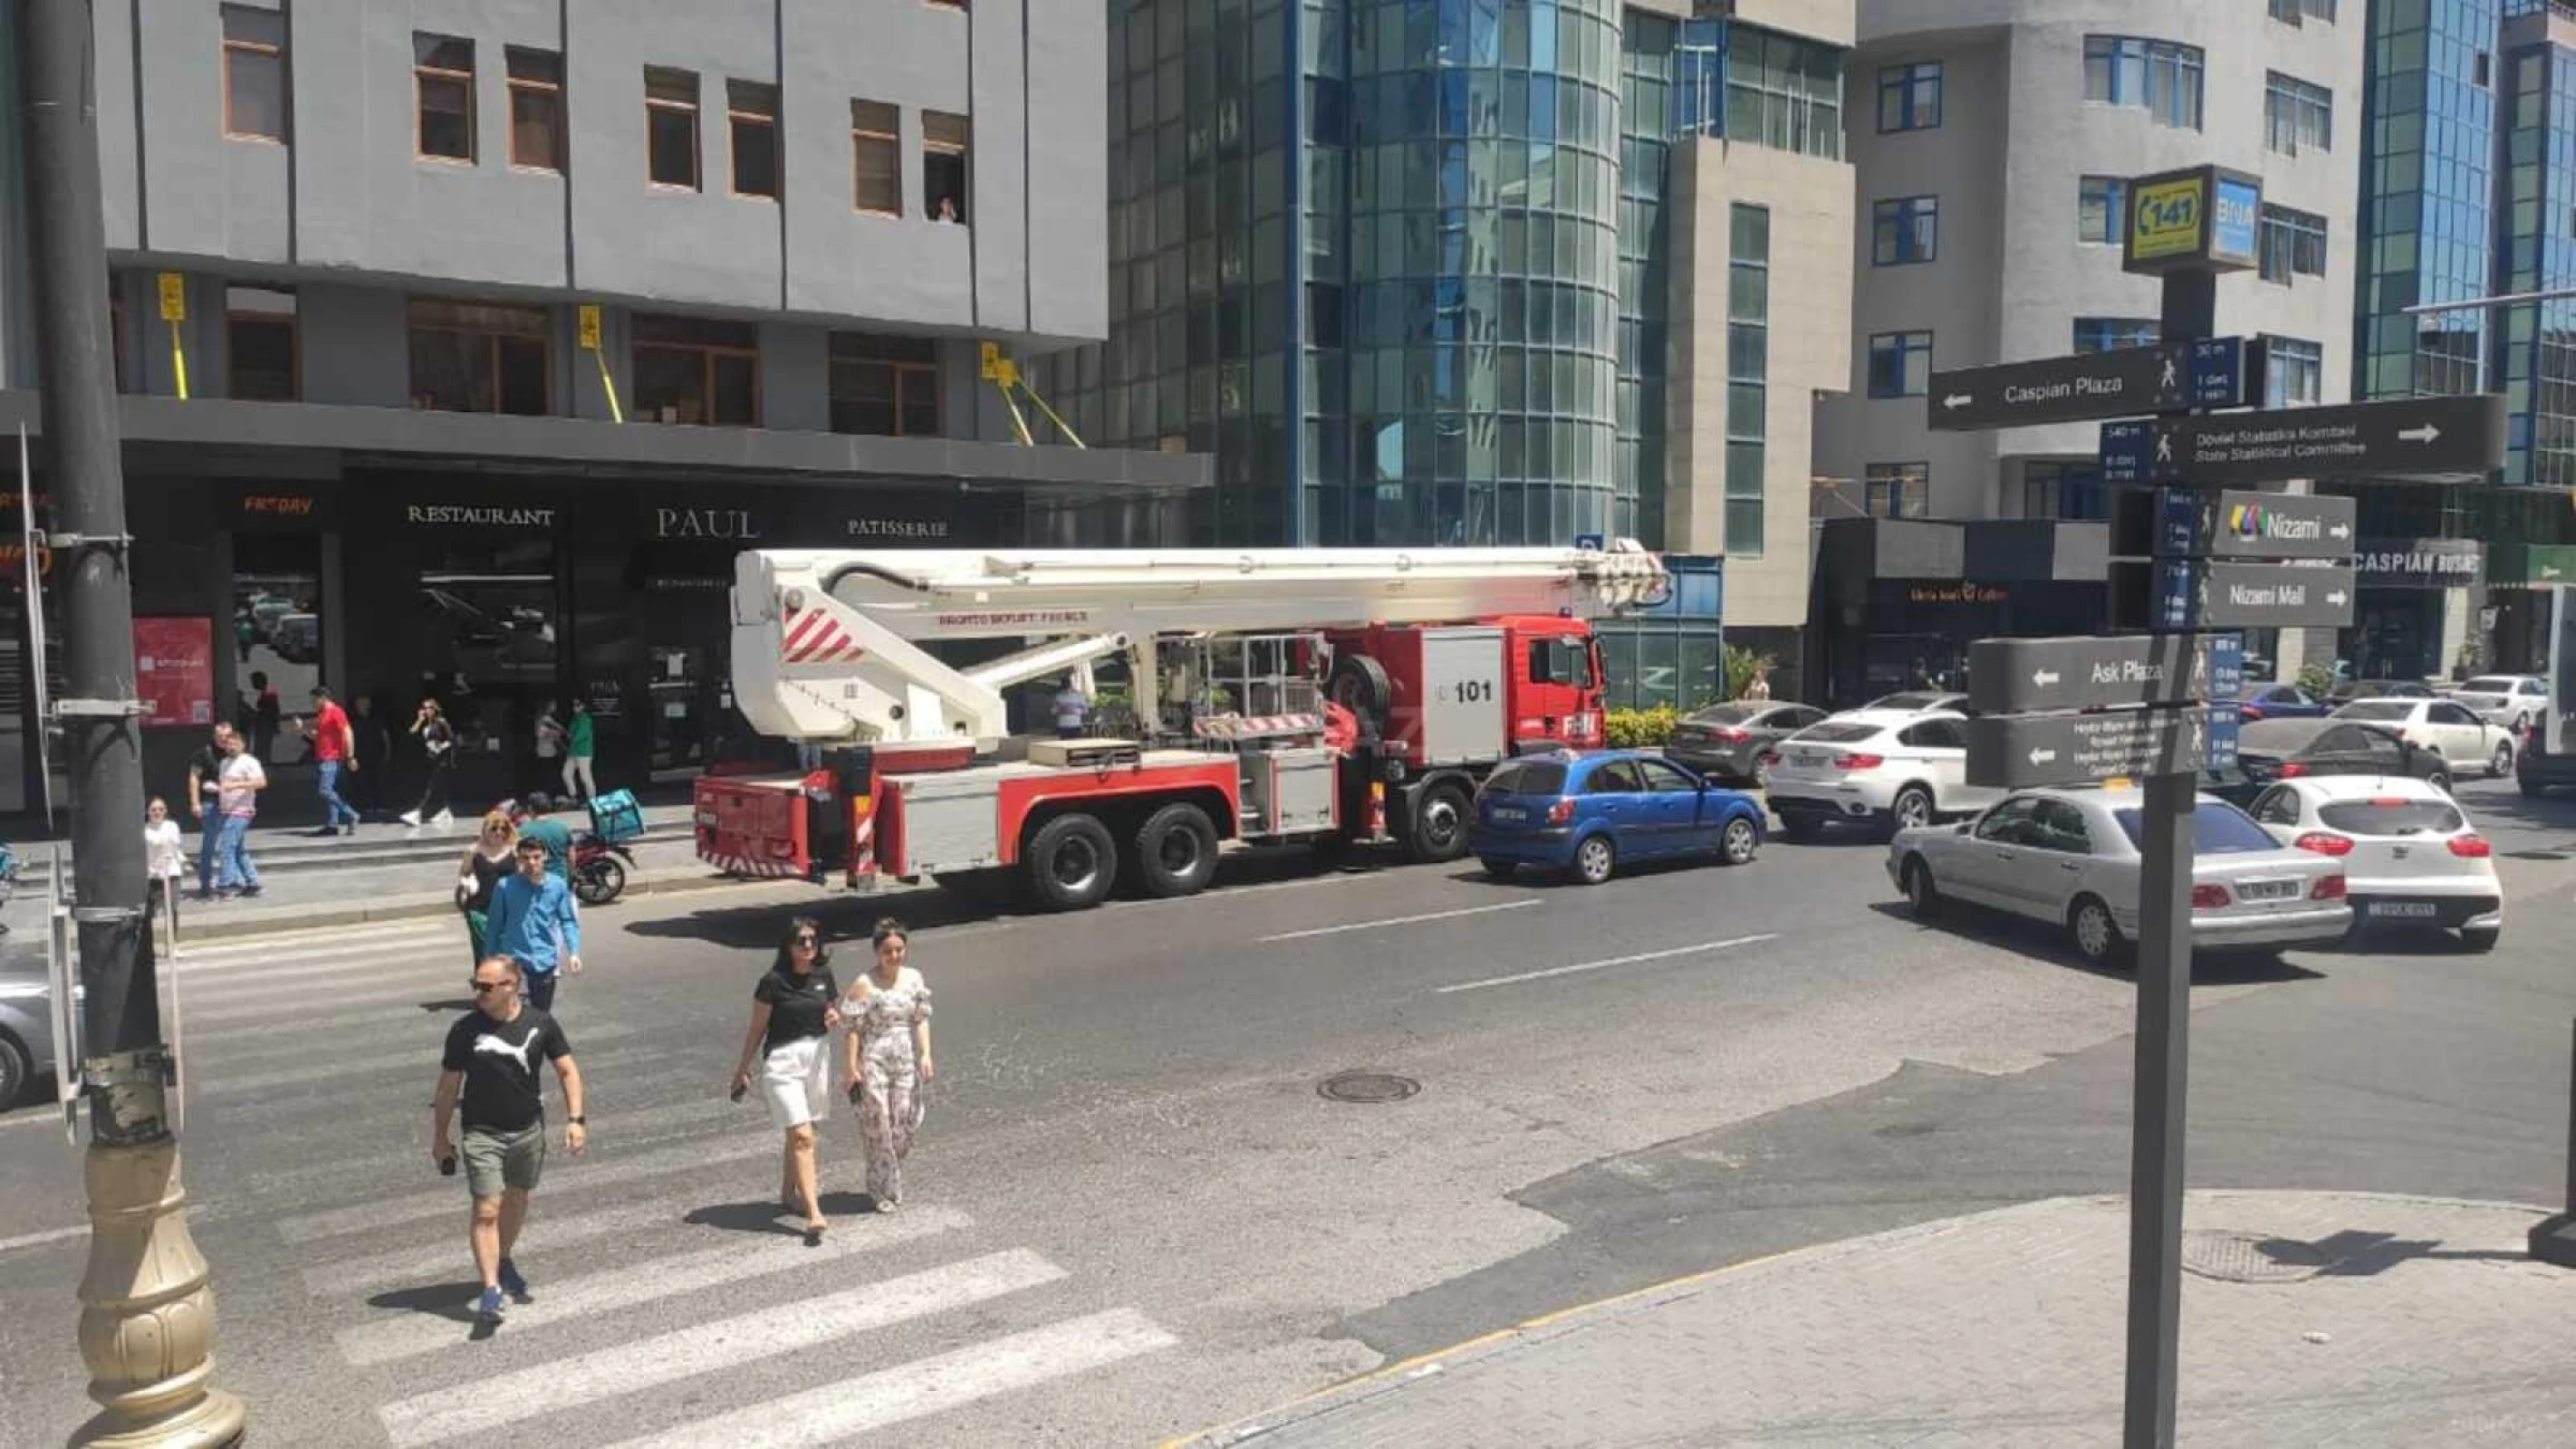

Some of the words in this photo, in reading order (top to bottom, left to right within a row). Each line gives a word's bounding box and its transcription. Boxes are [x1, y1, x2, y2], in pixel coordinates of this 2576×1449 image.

[2150, 198, 2191, 227] 141
[2004, 380, 2070, 406] Caspian
[2075, 377, 2122, 393] Plaza
[408, 505, 554, 527] RESTAURANT
[657, 509, 760, 538] PAUL
[2267, 513, 2321, 539] Nizami
[848, 521, 947, 536] PATISSERIE
[2353, 552, 2432, 572] CASPIAN
[2230, 585, 2275, 605] Nizami
[2278, 585, 2305, 605] Mall
[2091, 661, 2119, 684] Ask
[2122, 659, 2164, 683] Plaza
[1456, 681, 1492, 704] 101
